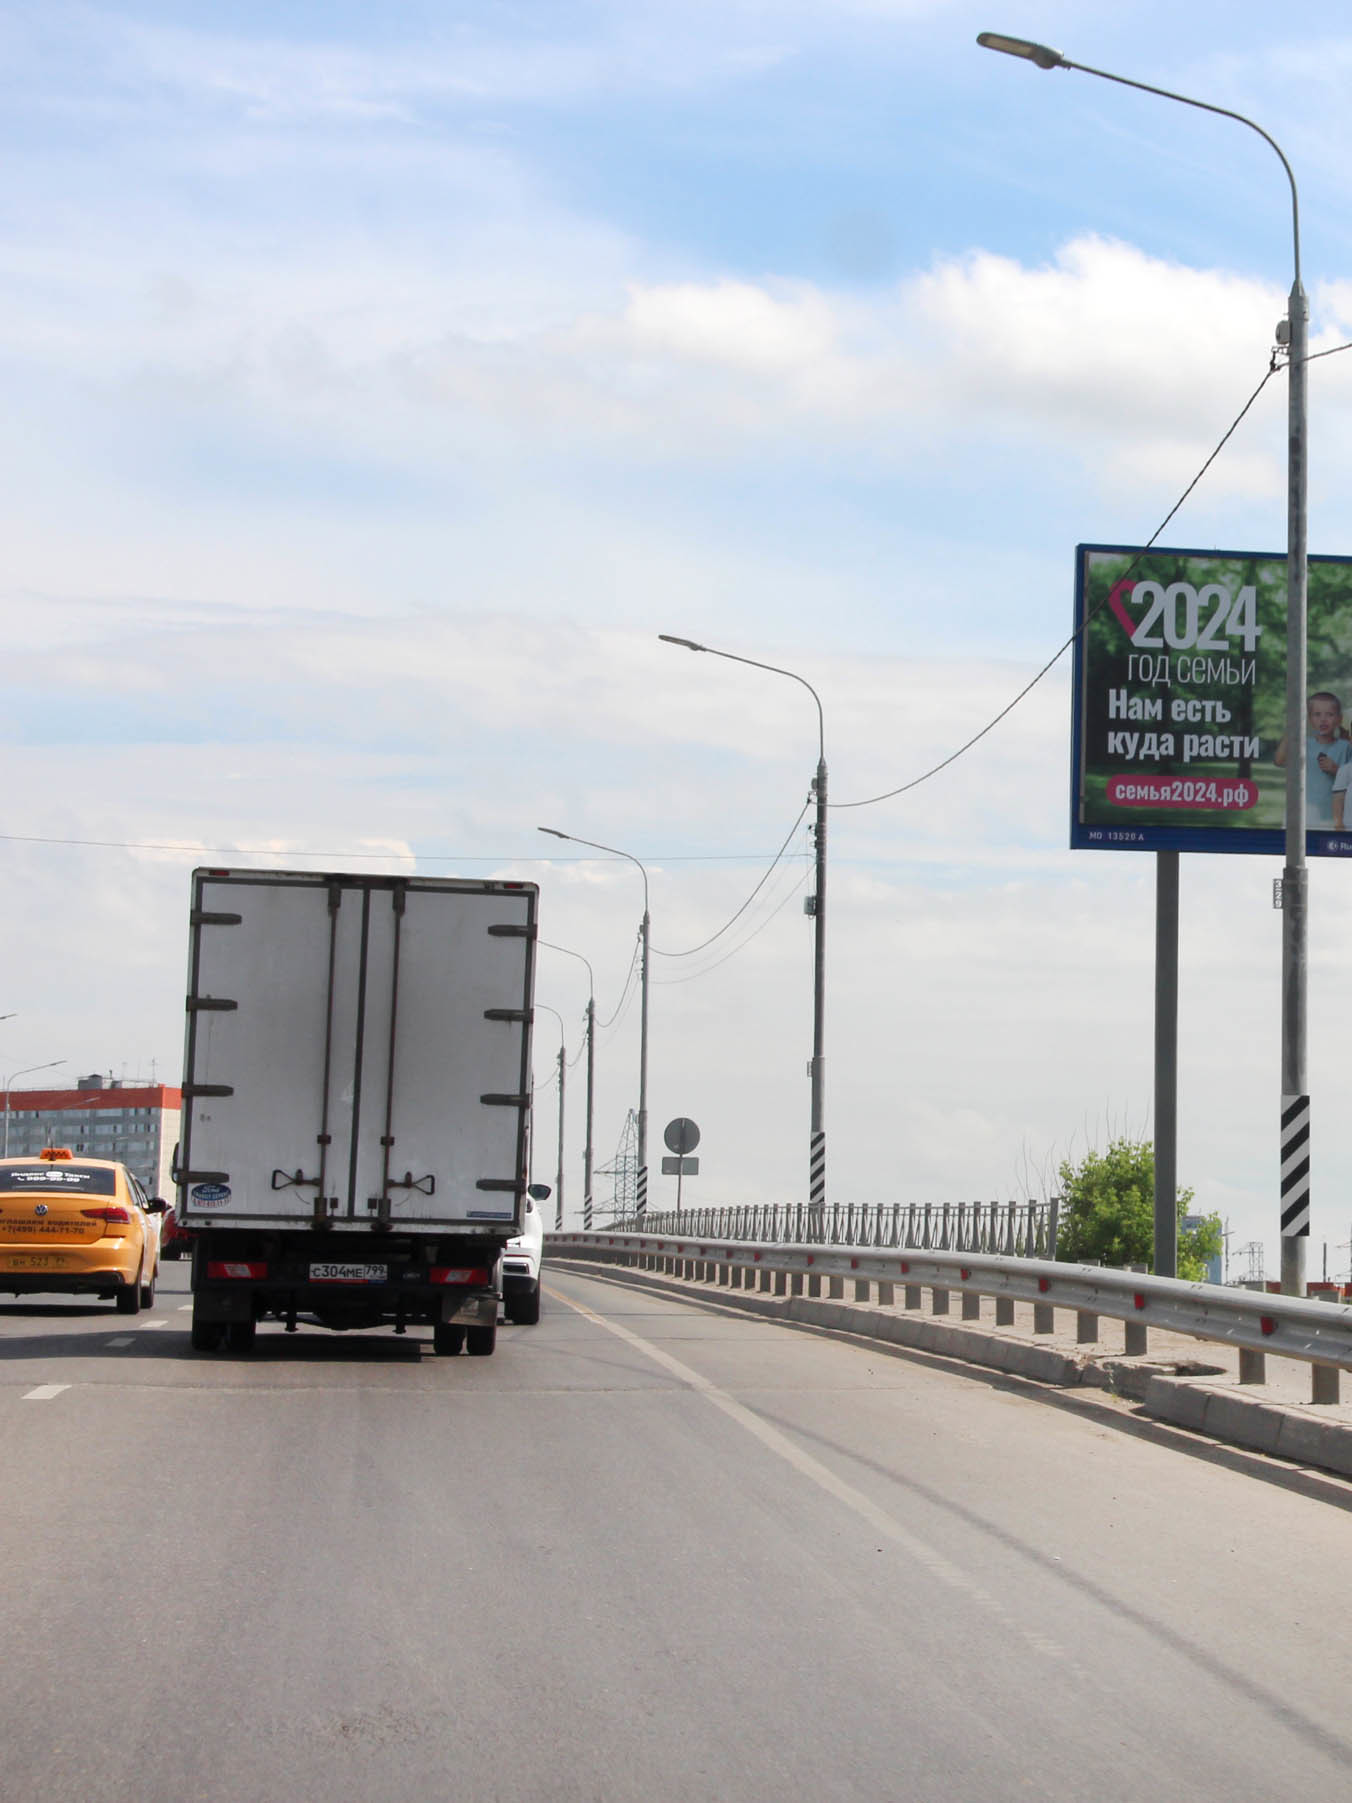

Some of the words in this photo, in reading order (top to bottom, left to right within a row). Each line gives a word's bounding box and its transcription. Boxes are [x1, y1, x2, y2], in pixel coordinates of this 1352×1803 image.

[1130, 580, 1263, 652] 2024
[1108, 688, 1162, 721] Нам
[1171, 699, 1232, 723] есть
[1107, 731, 1174, 760] куда
[1183, 733, 1259, 763] расти
[1115, 781, 1249, 807] семья2024.рф
[365, 1265, 385, 1275] 799
